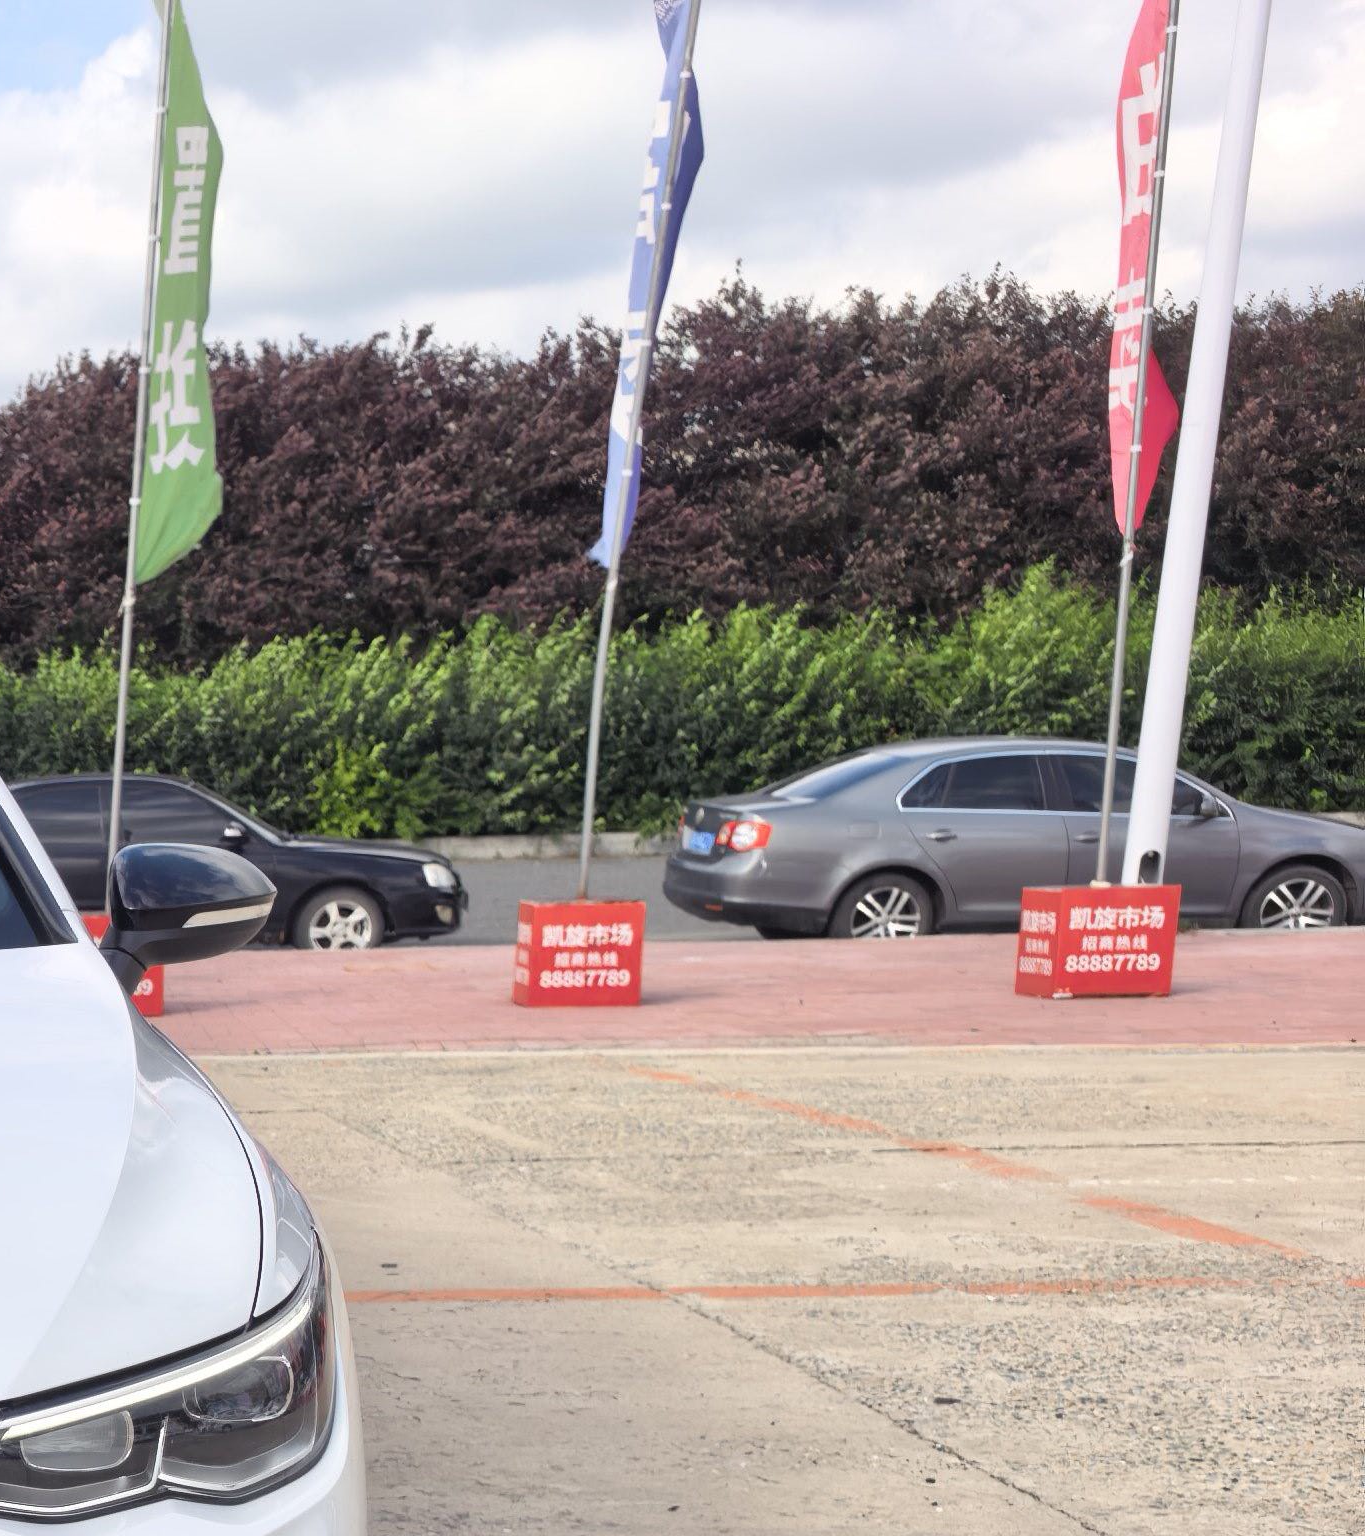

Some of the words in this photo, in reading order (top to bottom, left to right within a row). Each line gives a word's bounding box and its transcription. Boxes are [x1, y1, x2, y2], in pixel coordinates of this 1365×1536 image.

[1069, 905, 1166, 930] 凯旋市场
[541, 922, 634, 948] 凯旋市场
[1081, 934, 1148, 951] 招商热线
[1065, 953, 1161, 973] 88887789
[539, 969, 631, 988] 88887789
